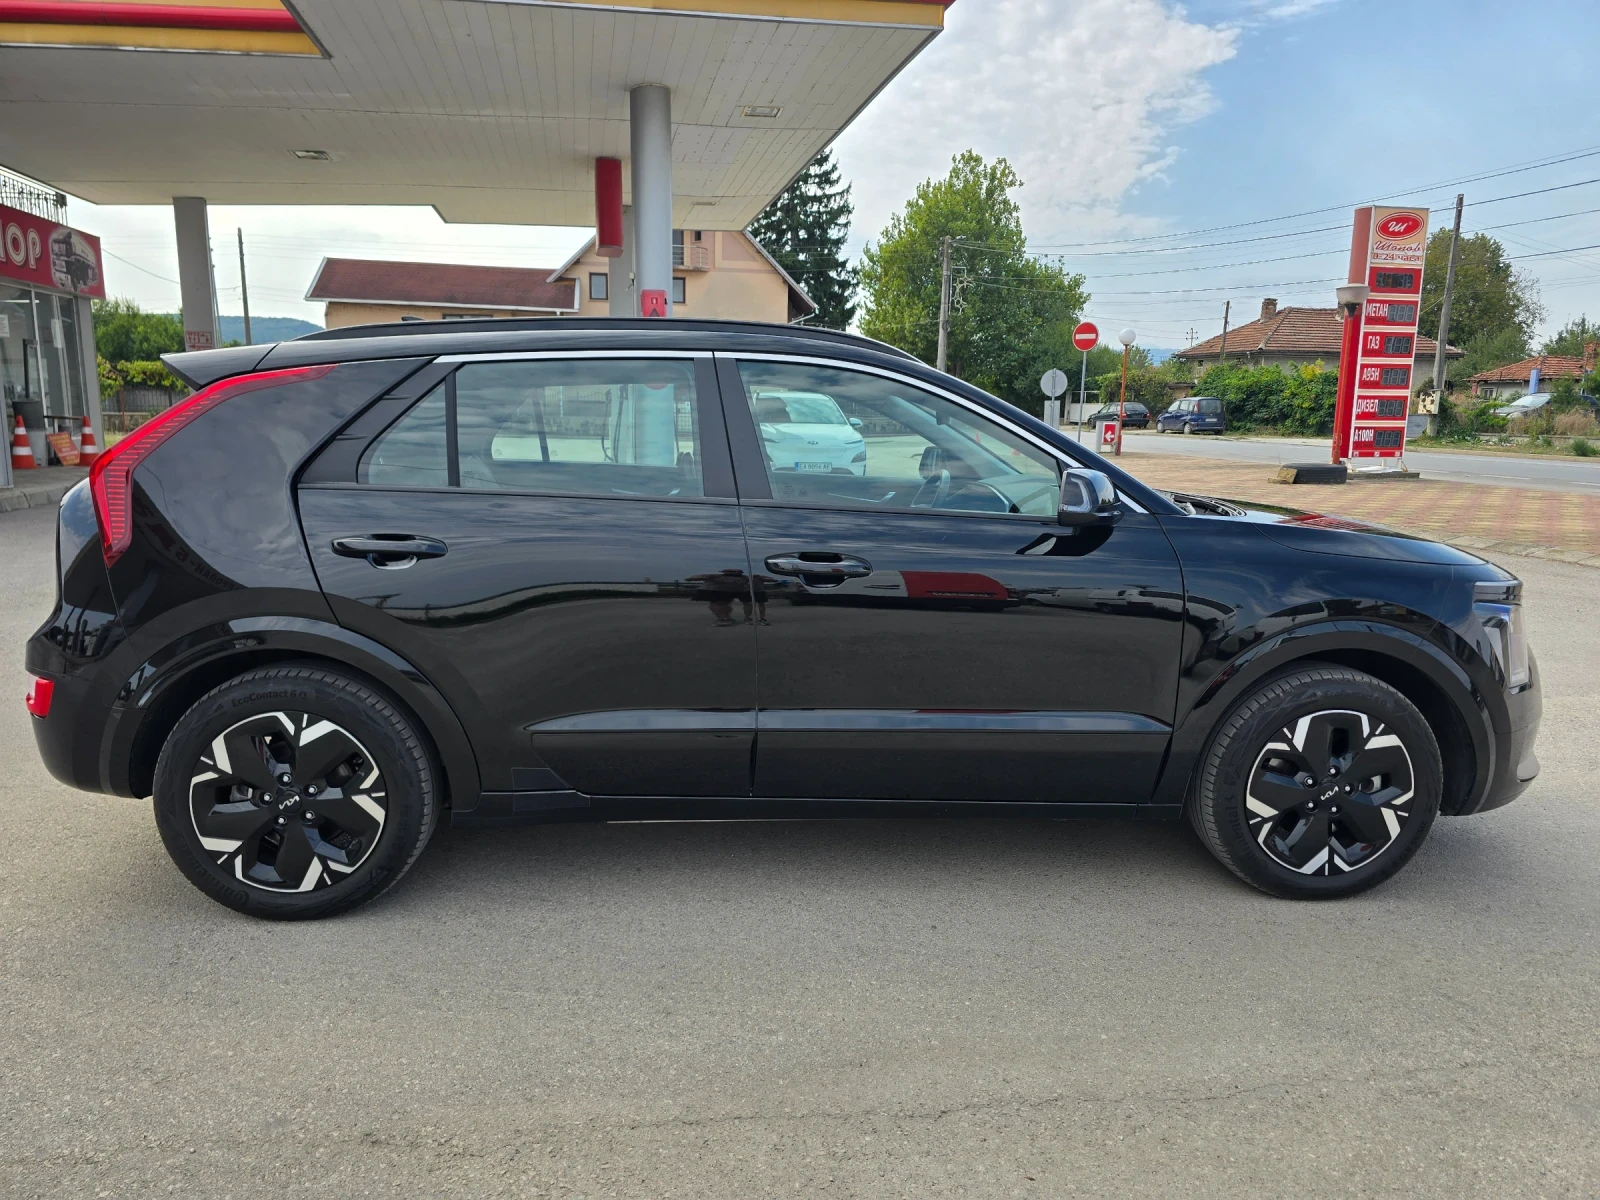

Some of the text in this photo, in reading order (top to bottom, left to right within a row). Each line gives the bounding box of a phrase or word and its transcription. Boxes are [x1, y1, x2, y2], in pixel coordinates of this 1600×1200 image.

[0, 219, 41, 269] OP
[1365, 303, 1389, 317] МЕТАН
[1367, 335, 1380, 349] ГАЗ
[1355, 399, 1379, 415] ДИЗЕЛ
[231, 690, 288, 708] EcoContact
